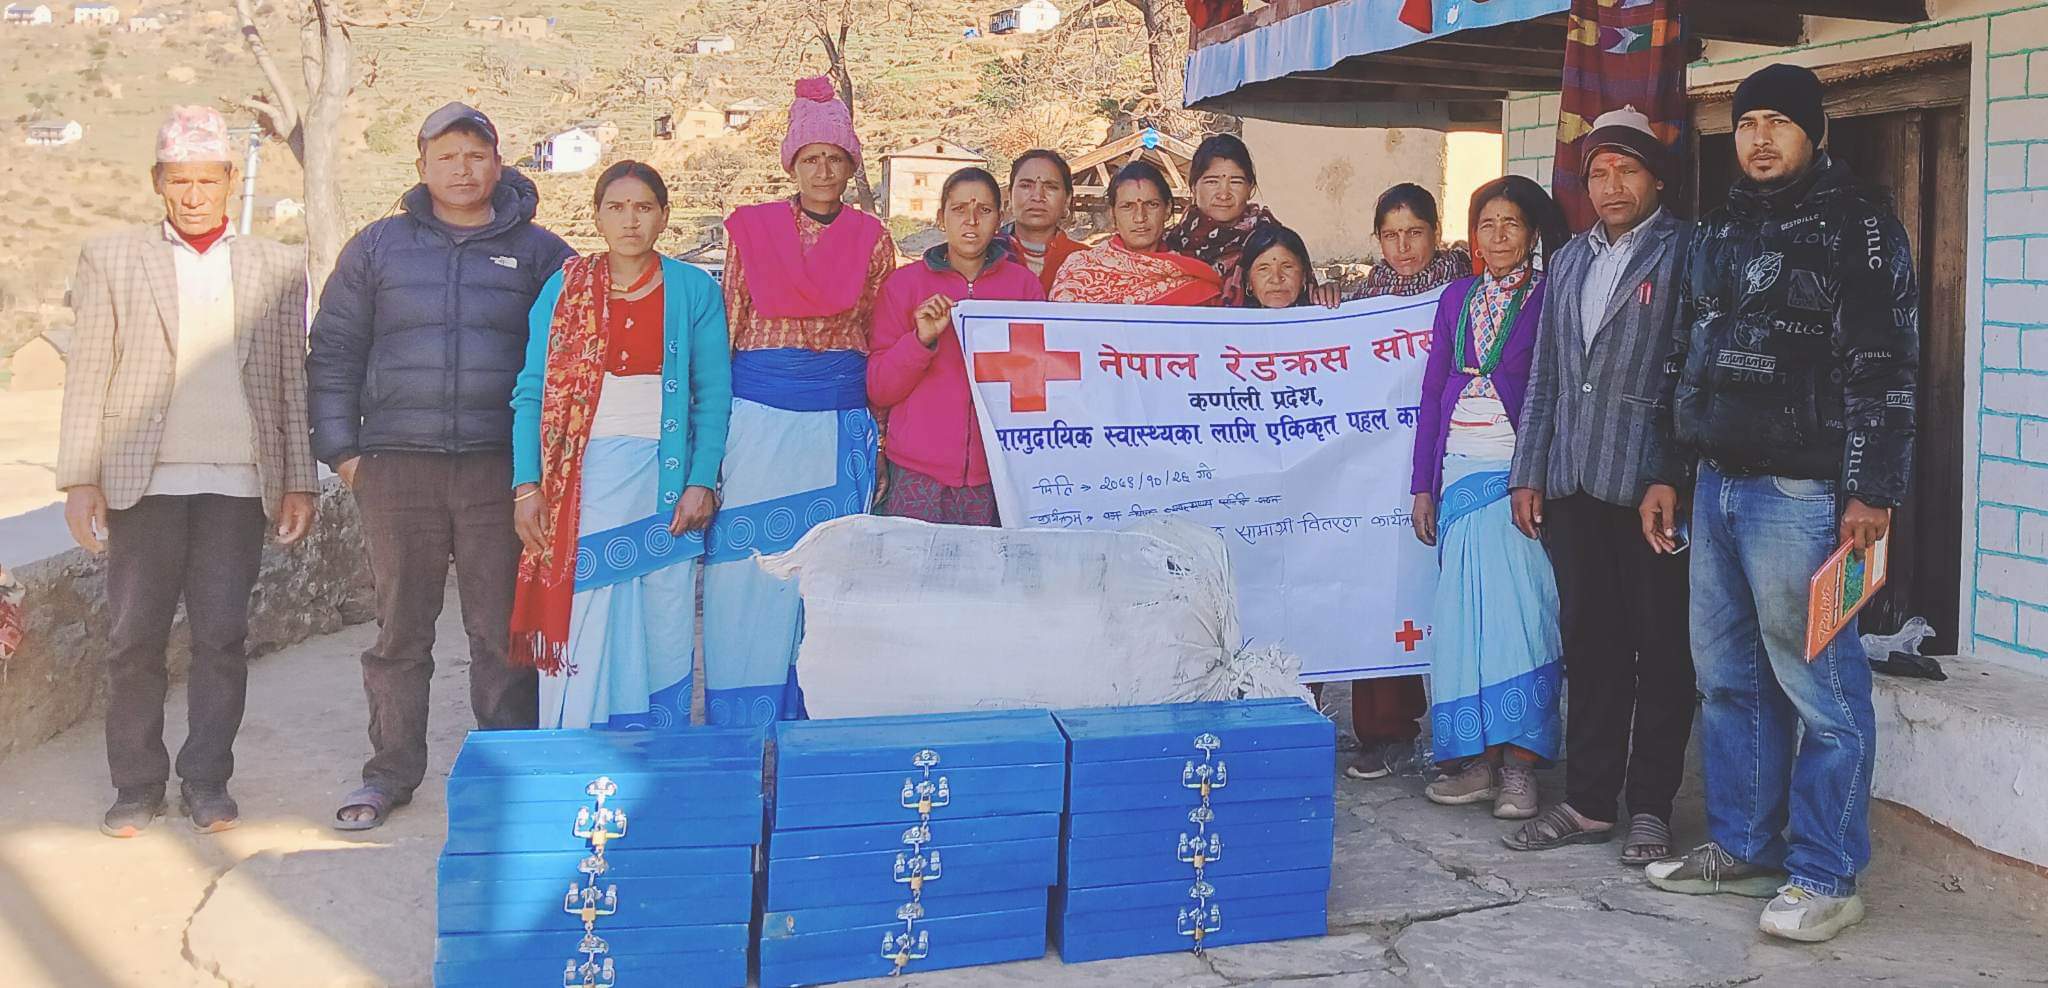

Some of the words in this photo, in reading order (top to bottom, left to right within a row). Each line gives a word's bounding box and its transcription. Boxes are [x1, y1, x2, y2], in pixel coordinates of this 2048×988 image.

[1792, 232, 1842, 251] LOVE
[1863, 216, 1883, 271] DILLC
[1774, 319, 1825, 336] DILLC
[1098, 343, 1200, 381] नेपाल
[1220, 344, 1350, 382] रेडक्रस
[1188, 386, 1264, 412] कर्णाली
[1104, 424, 1203, 449] स्वास्थ्यका
[1210, 417, 1259, 444] लागि
[1265, 415, 1340, 446] एकिकृत
[1346, 408, 1390, 433] पहल
[1846, 435, 1866, 491] DILLC
[1032, 474, 1075, 497] मिति
[1296, 511, 1363, 534] वितरण
